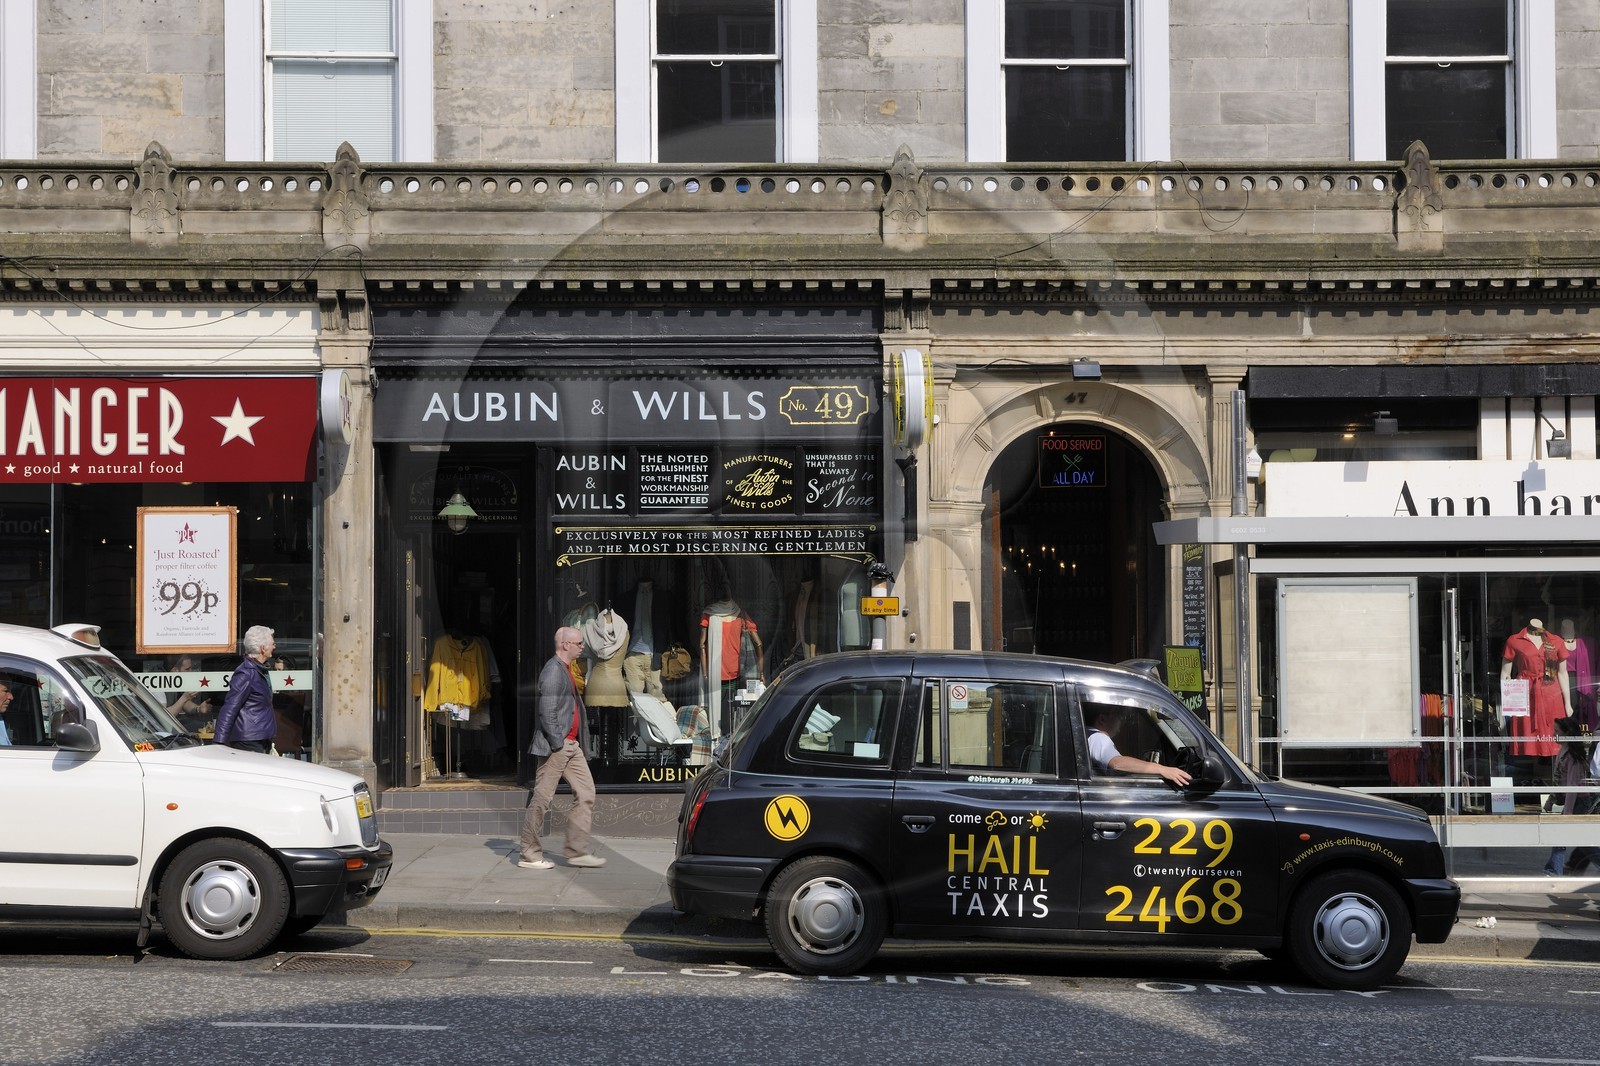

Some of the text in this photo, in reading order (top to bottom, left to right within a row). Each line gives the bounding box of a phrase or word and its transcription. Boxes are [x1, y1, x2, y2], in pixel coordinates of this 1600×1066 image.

[422, 390, 766, 422] AUBIN & WILLS
[815, 392, 854, 420] 49
[0, 387, 185, 456] ANGER
[1042, 439, 1103, 451] FOOD SERVED
[556, 455, 626, 471] AUBIN
[640, 454, 709, 463] THE NOTED
[723, 454, 794, 470] MANUFACTURERS
[24, 461, 184, 477] good natural food
[640, 464, 709, 472] ESTABLISHMENT
[585, 476, 596, 489] &
[673, 474, 709, 483] FINEST
[1053, 471, 1095, 484] ALL DAY
[640, 484, 709, 492] WORKMANSHIP
[805, 469, 874, 504] Second to
[419, 496, 449, 506] AUBI
[556, 493, 626, 510] WILLS
[640, 496, 709, 504] GUARANTEED
[725, 493, 793, 509] FINEST GOODS
[823, 485, 875, 508] None
[1393, 480, 1491, 516] Ann
[566, 531, 658, 541] EXCLUSIVELY
[662, 532, 682, 540] FOR
[712, 530, 749, 539] MOST
[755, 530, 812, 539] REFINED
[817, 529, 865, 539] LADIES
[566, 541, 866, 553] AND THE MOST DISCERNING GENTLEMEN
[155, 562, 217, 573] proper filter coffee
[160, 581, 219, 616] 99p
[1167, 649, 1200, 670] Tequila
[1182, 693, 1203, 710] ACKS
[638, 767, 698, 782] AUBIN
[948, 813, 1024, 825] come or
[1133, 817, 1234, 868] 229
[948, 833, 1050, 875] HAIL
[1293, 837, 1404, 867] www.taxis-edinburgh.co.uk
[1148, 866, 1242, 878] twentyfourseven
[947, 875, 1048, 892] CENTRAL
[947, 892, 1049, 919] TAXIS
[1104, 877, 1243, 933] 2468
[610, 965, 1031, 985] LOADING
[1137, 981, 1392, 998] ONLY
